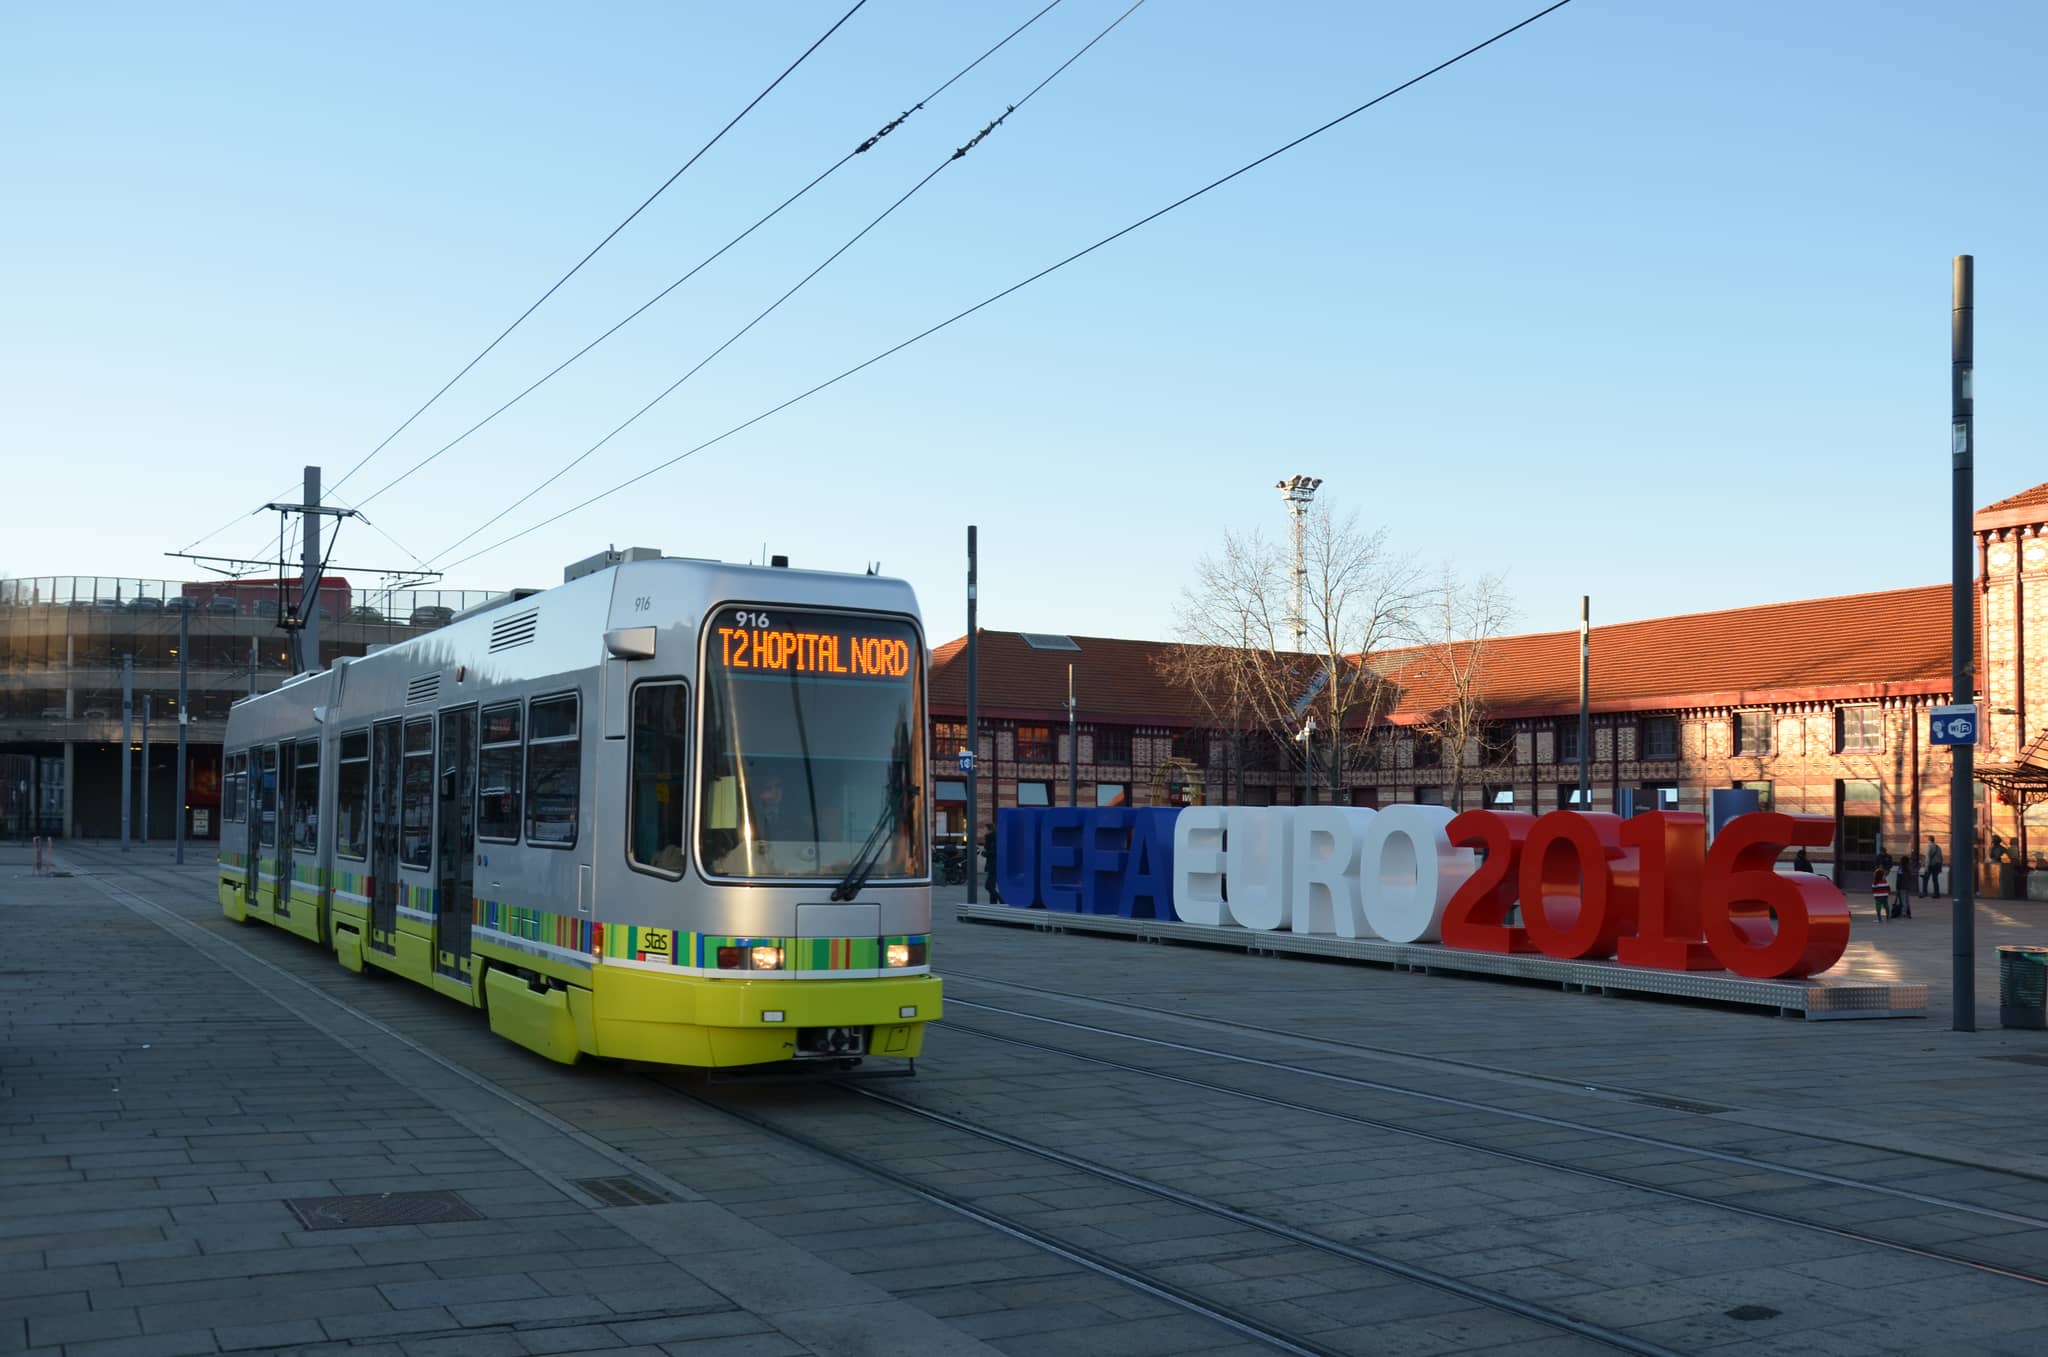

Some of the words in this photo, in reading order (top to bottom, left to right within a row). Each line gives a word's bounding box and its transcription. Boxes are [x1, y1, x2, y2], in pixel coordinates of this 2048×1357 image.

[635, 597, 650, 612] 916
[735, 611, 770, 628] 916
[718, 628, 749, 667] T2
[753, 630, 848, 673] HOPITAL
[851, 637, 909, 676] NORD
[998, 806, 1178, 922] UEFA
[1174, 804, 1470, 943] EURO
[1441, 808, 1850, 979] 2016
[644, 927, 668, 950] stas
